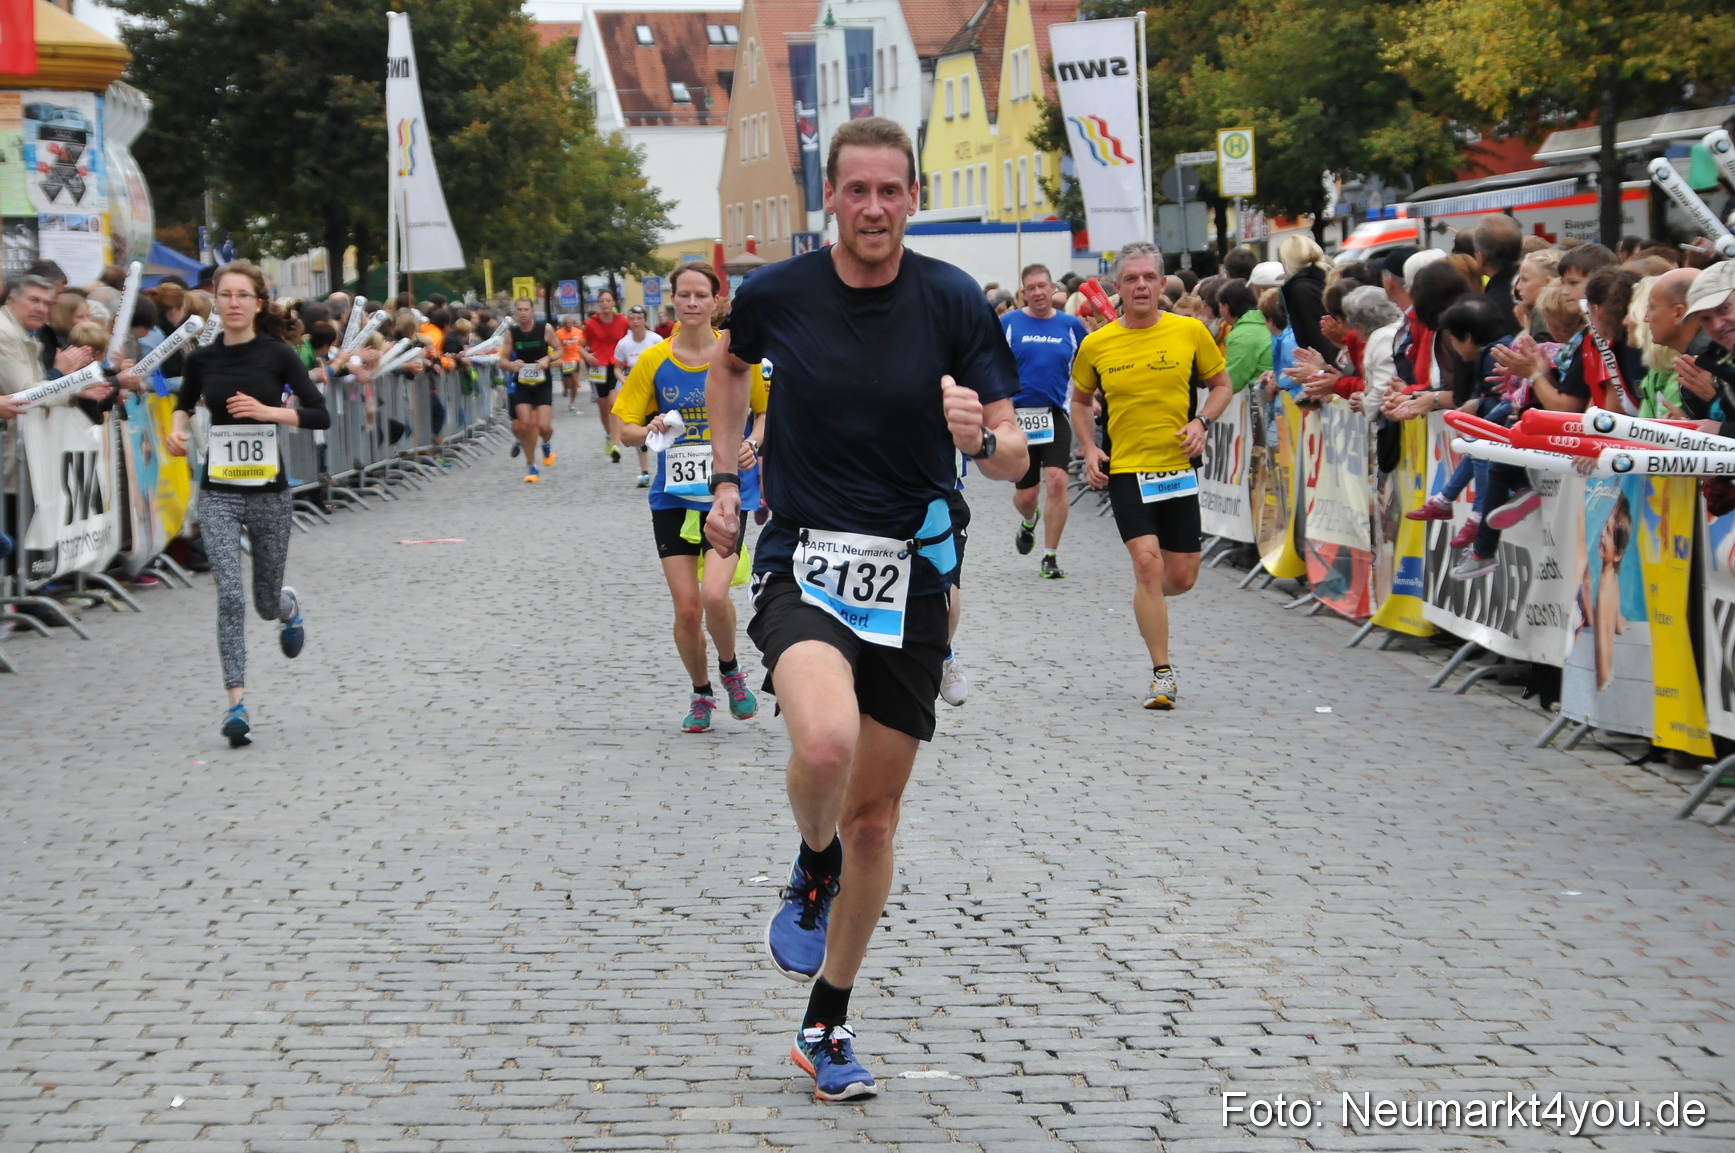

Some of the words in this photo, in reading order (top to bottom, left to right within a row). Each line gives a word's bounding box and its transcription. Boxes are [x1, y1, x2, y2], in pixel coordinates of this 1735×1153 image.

[1108, 363, 1135, 374] Dieter
[1017, 415, 1048, 430] 2899
[223, 440, 264, 462] 108
[222, 468, 265, 478] Katharina
[672, 459, 713, 483] 331
[1647, 456, 1699, 473] BMW
[1158, 482, 1181, 492] Dieter
[804, 541, 839, 553] PARTL
[842, 544, 894, 558] Neumarkt
[806, 555, 900, 604] 2132
